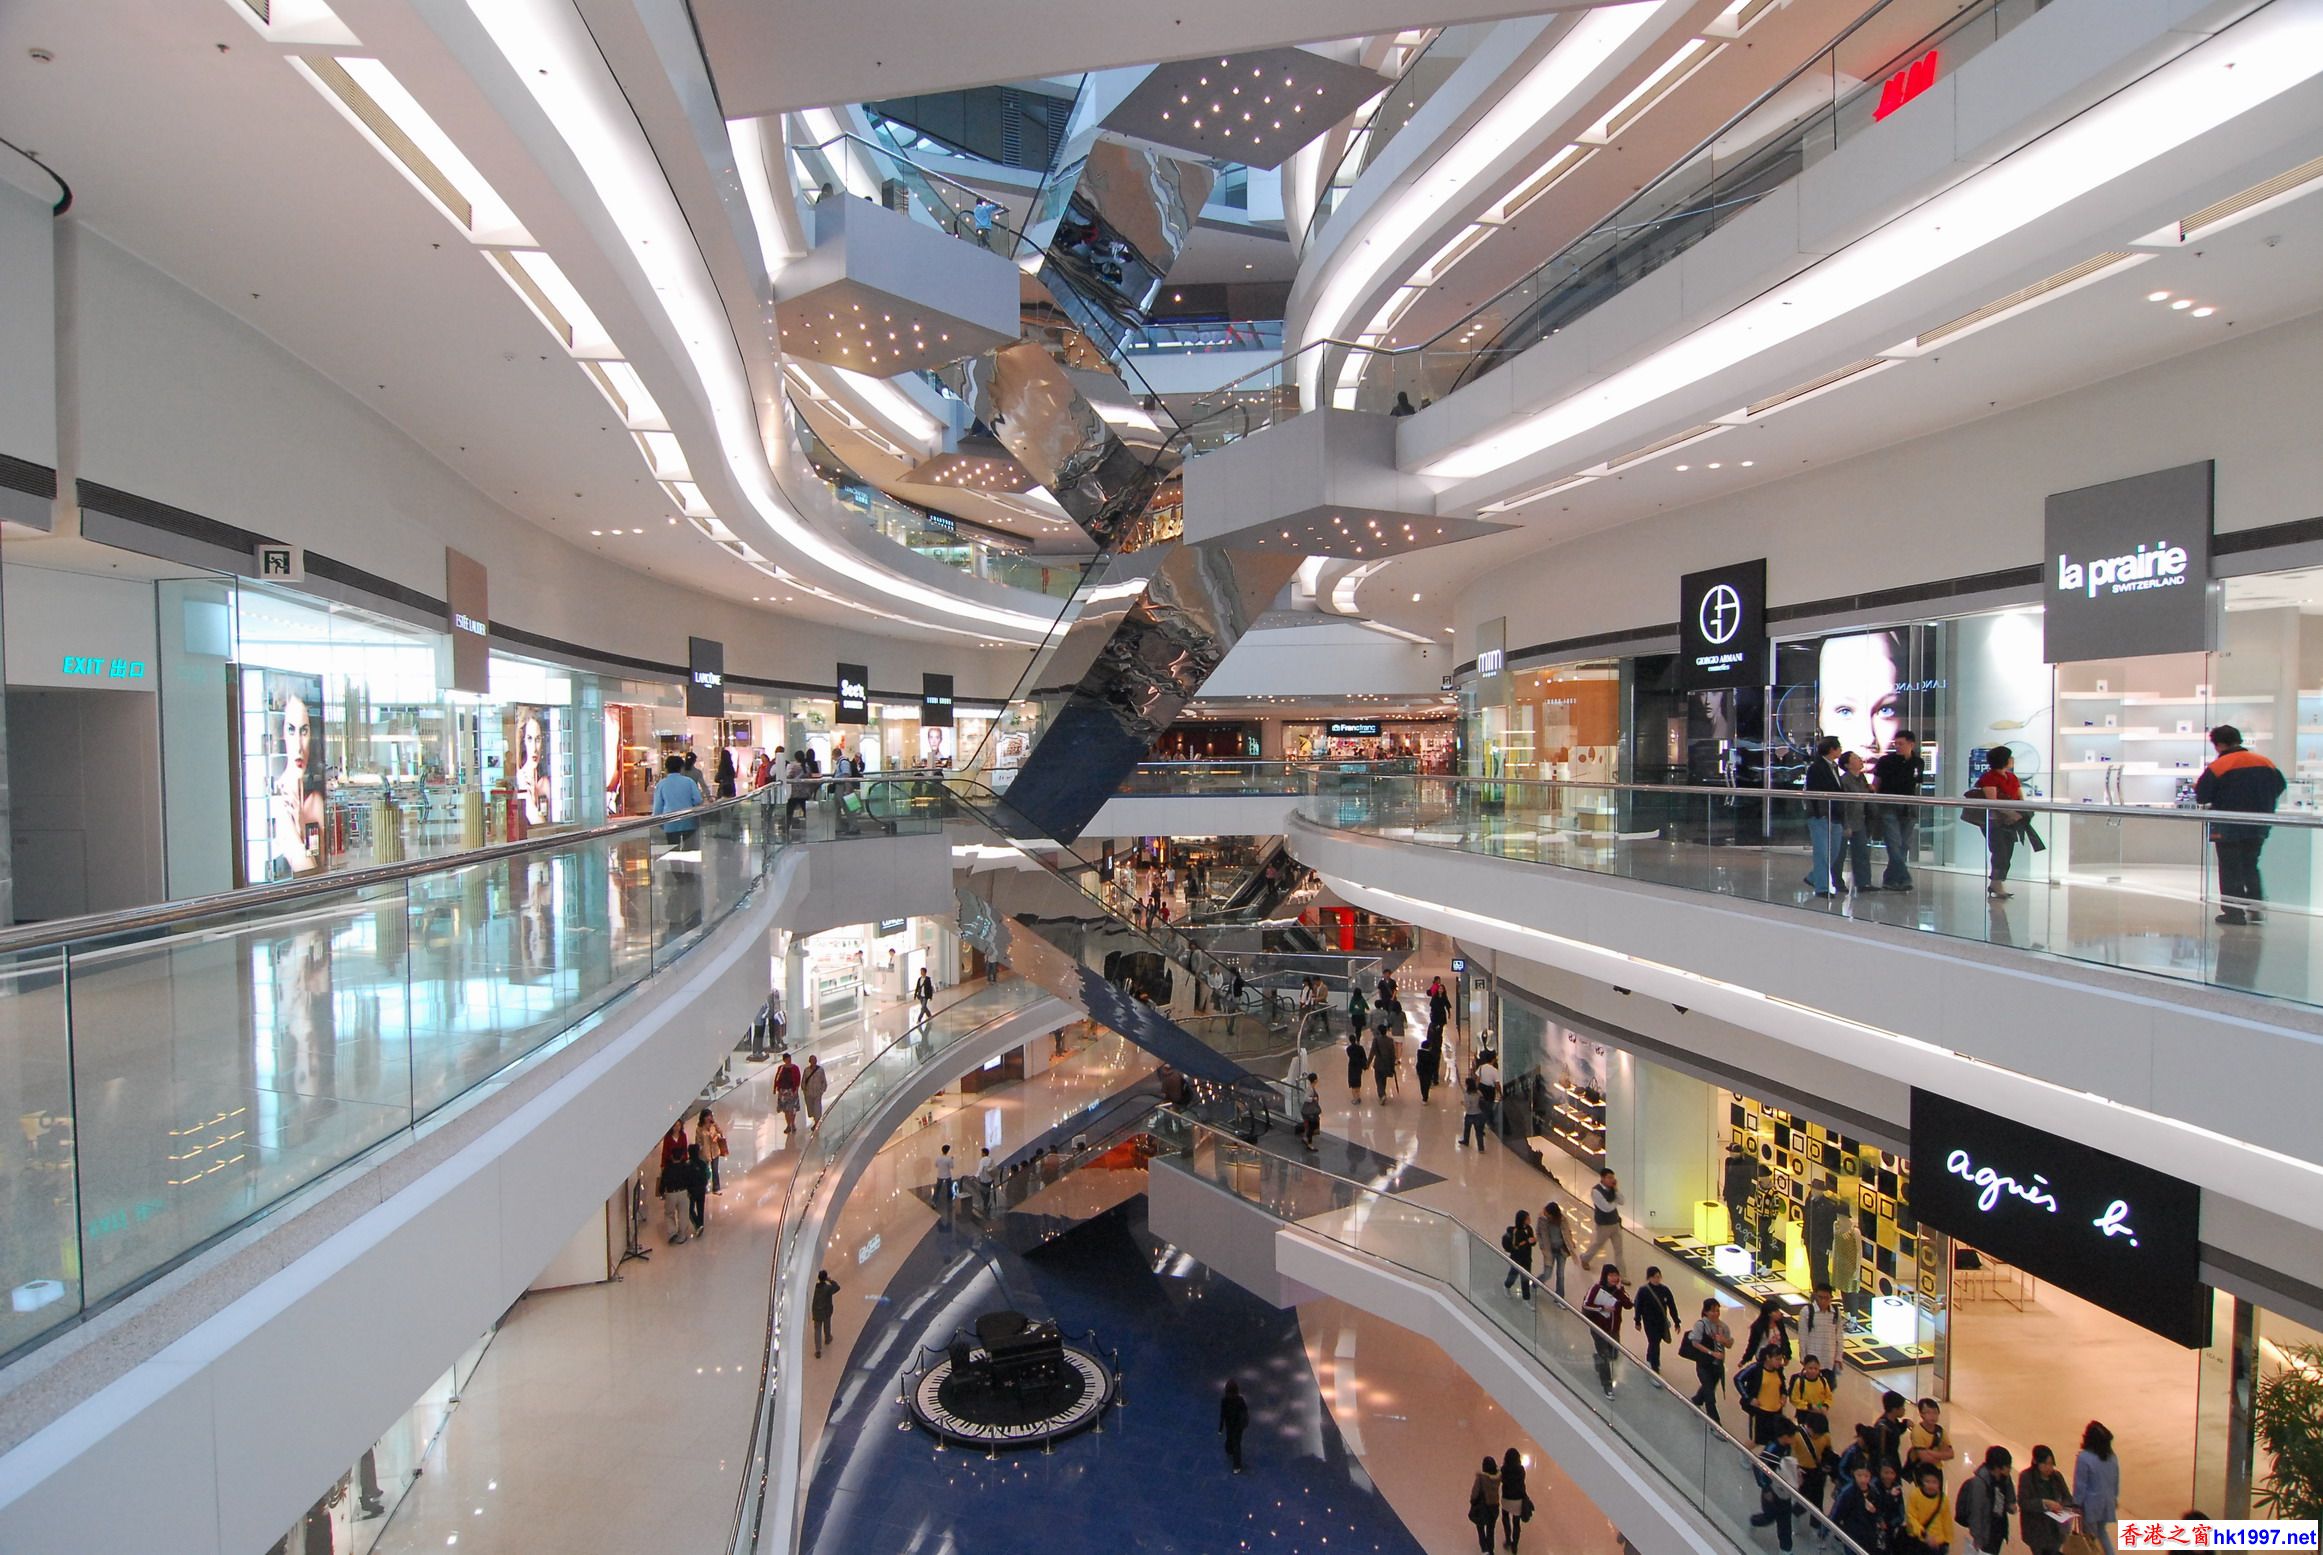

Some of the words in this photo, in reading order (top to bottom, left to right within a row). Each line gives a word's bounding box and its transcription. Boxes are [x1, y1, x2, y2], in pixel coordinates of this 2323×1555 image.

[2058, 554, 2084, 591] la
[2087, 541, 2187, 598] prairie
[2111, 575, 2185, 594] SWITZERLAND
[63, 656, 105, 676] EXIT
[109, 658, 145, 679] 出口
[1696, 656, 1719, 665] GIORGIO
[1719, 653, 1743, 663] ARMANI
[1340, 723, 1377, 732] Francfranc
[1946, 1149, 2058, 1212] agnès
[2092, 1199, 2139, 1247] b.
